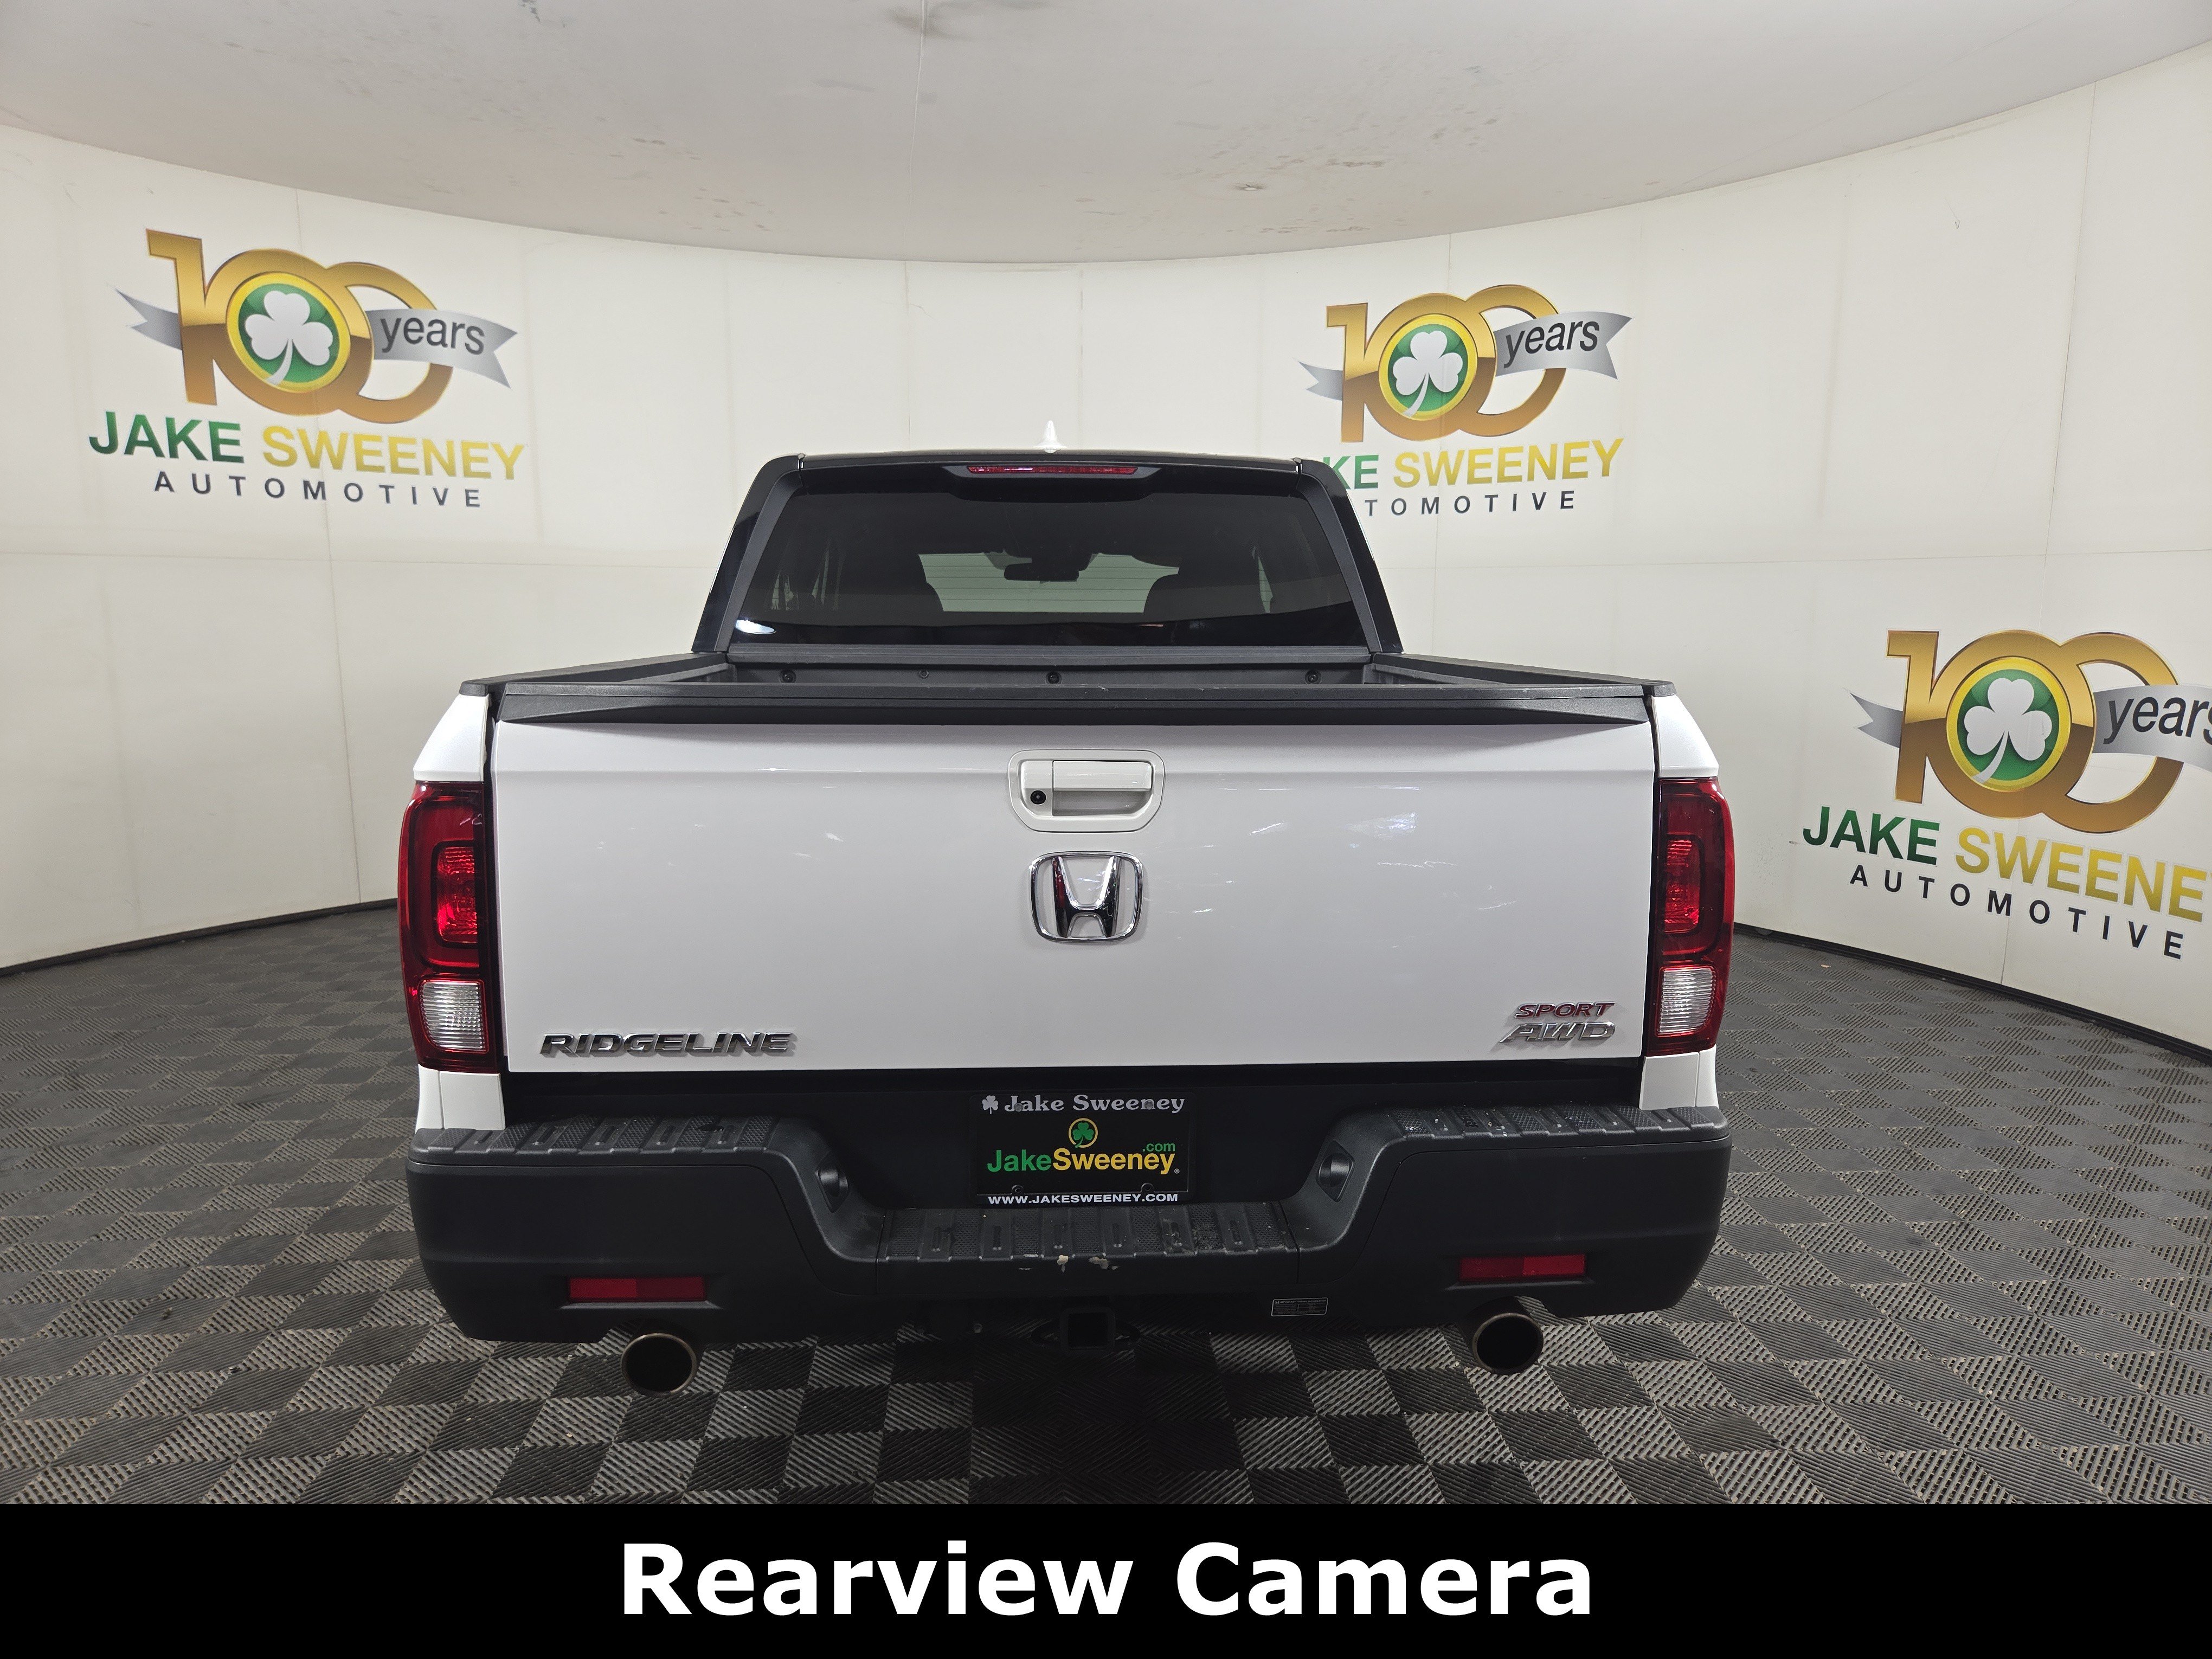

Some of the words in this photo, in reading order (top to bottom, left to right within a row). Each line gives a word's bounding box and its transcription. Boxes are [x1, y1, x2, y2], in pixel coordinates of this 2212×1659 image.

[380, 313, 486, 356] years
[1503, 320, 1600, 369] years
[89, 411, 245, 464] JAKE
[262, 426, 524, 480] SWEENEY
[1322, 454, 1379, 490] KE
[1393, 438, 1624, 489] SWEENEY
[154, 471, 481, 508] AUTOMOTIVE
[1364, 490, 1574, 517] TOMOTIVE
[1803, 806, 1940, 865] JAKE
[1955, 827, 2212, 922] SWEENE
[1849, 864, 2184, 960] AUTOMOTIVE
[1514, 1002, 1616, 1018] SPORT
[539, 1031, 794, 1055] RIDGELINE
[1498, 1022, 1616, 1043] AWD
[1004, 1095, 1065, 1112] Jake
[1072, 1094, 1185, 1114] Sweeney
[1142, 1142, 1176, 1152] .com
[988, 1193, 1179, 1204] WWW.JAKESWEENEY.COM
